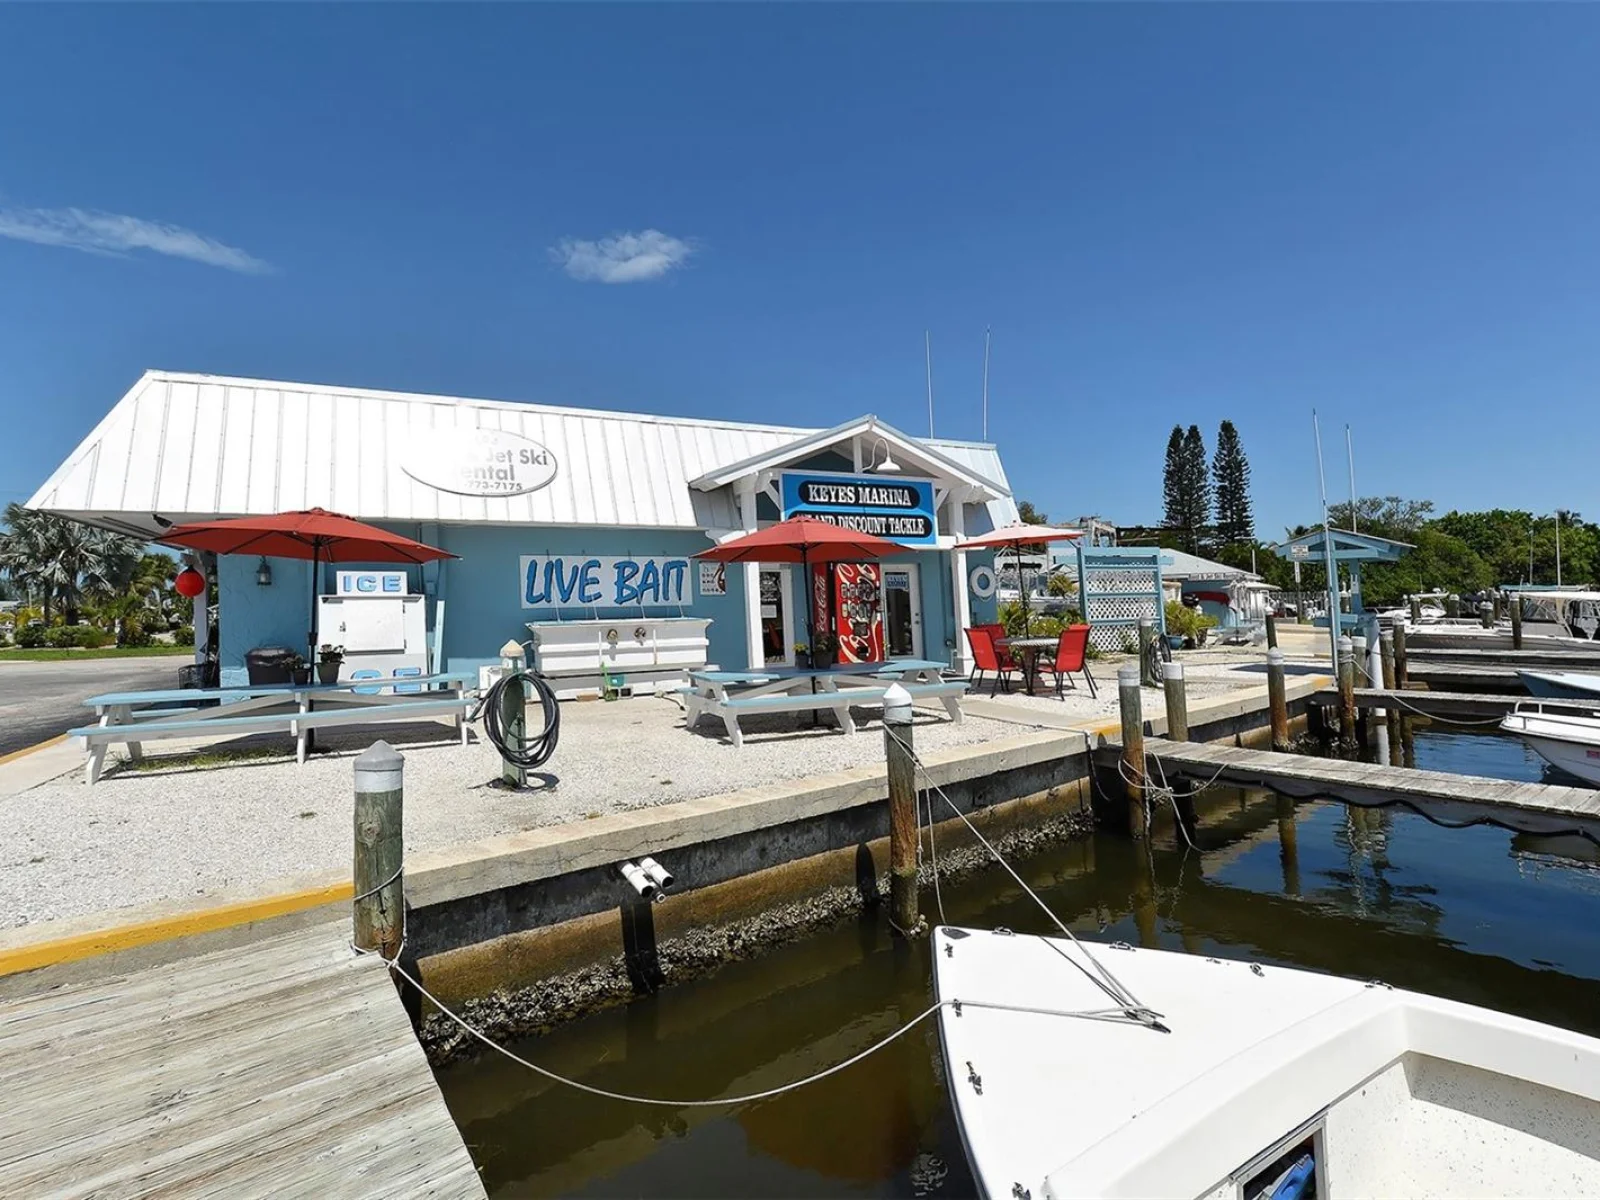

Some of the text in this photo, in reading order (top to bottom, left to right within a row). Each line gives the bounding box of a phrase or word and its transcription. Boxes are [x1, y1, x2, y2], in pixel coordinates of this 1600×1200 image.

[486, 448, 549, 466] Jet Ski
[460, 464, 515, 481] ental
[808, 484, 912, 506] KEYES MARINA
[838, 515, 887, 534] DISCOUNT
[888, 517, 925, 535] TACKLE
[343, 575, 402, 592] ICE
[525, 558, 602, 604] LIVE
[613, 559, 688, 605] BAIT
